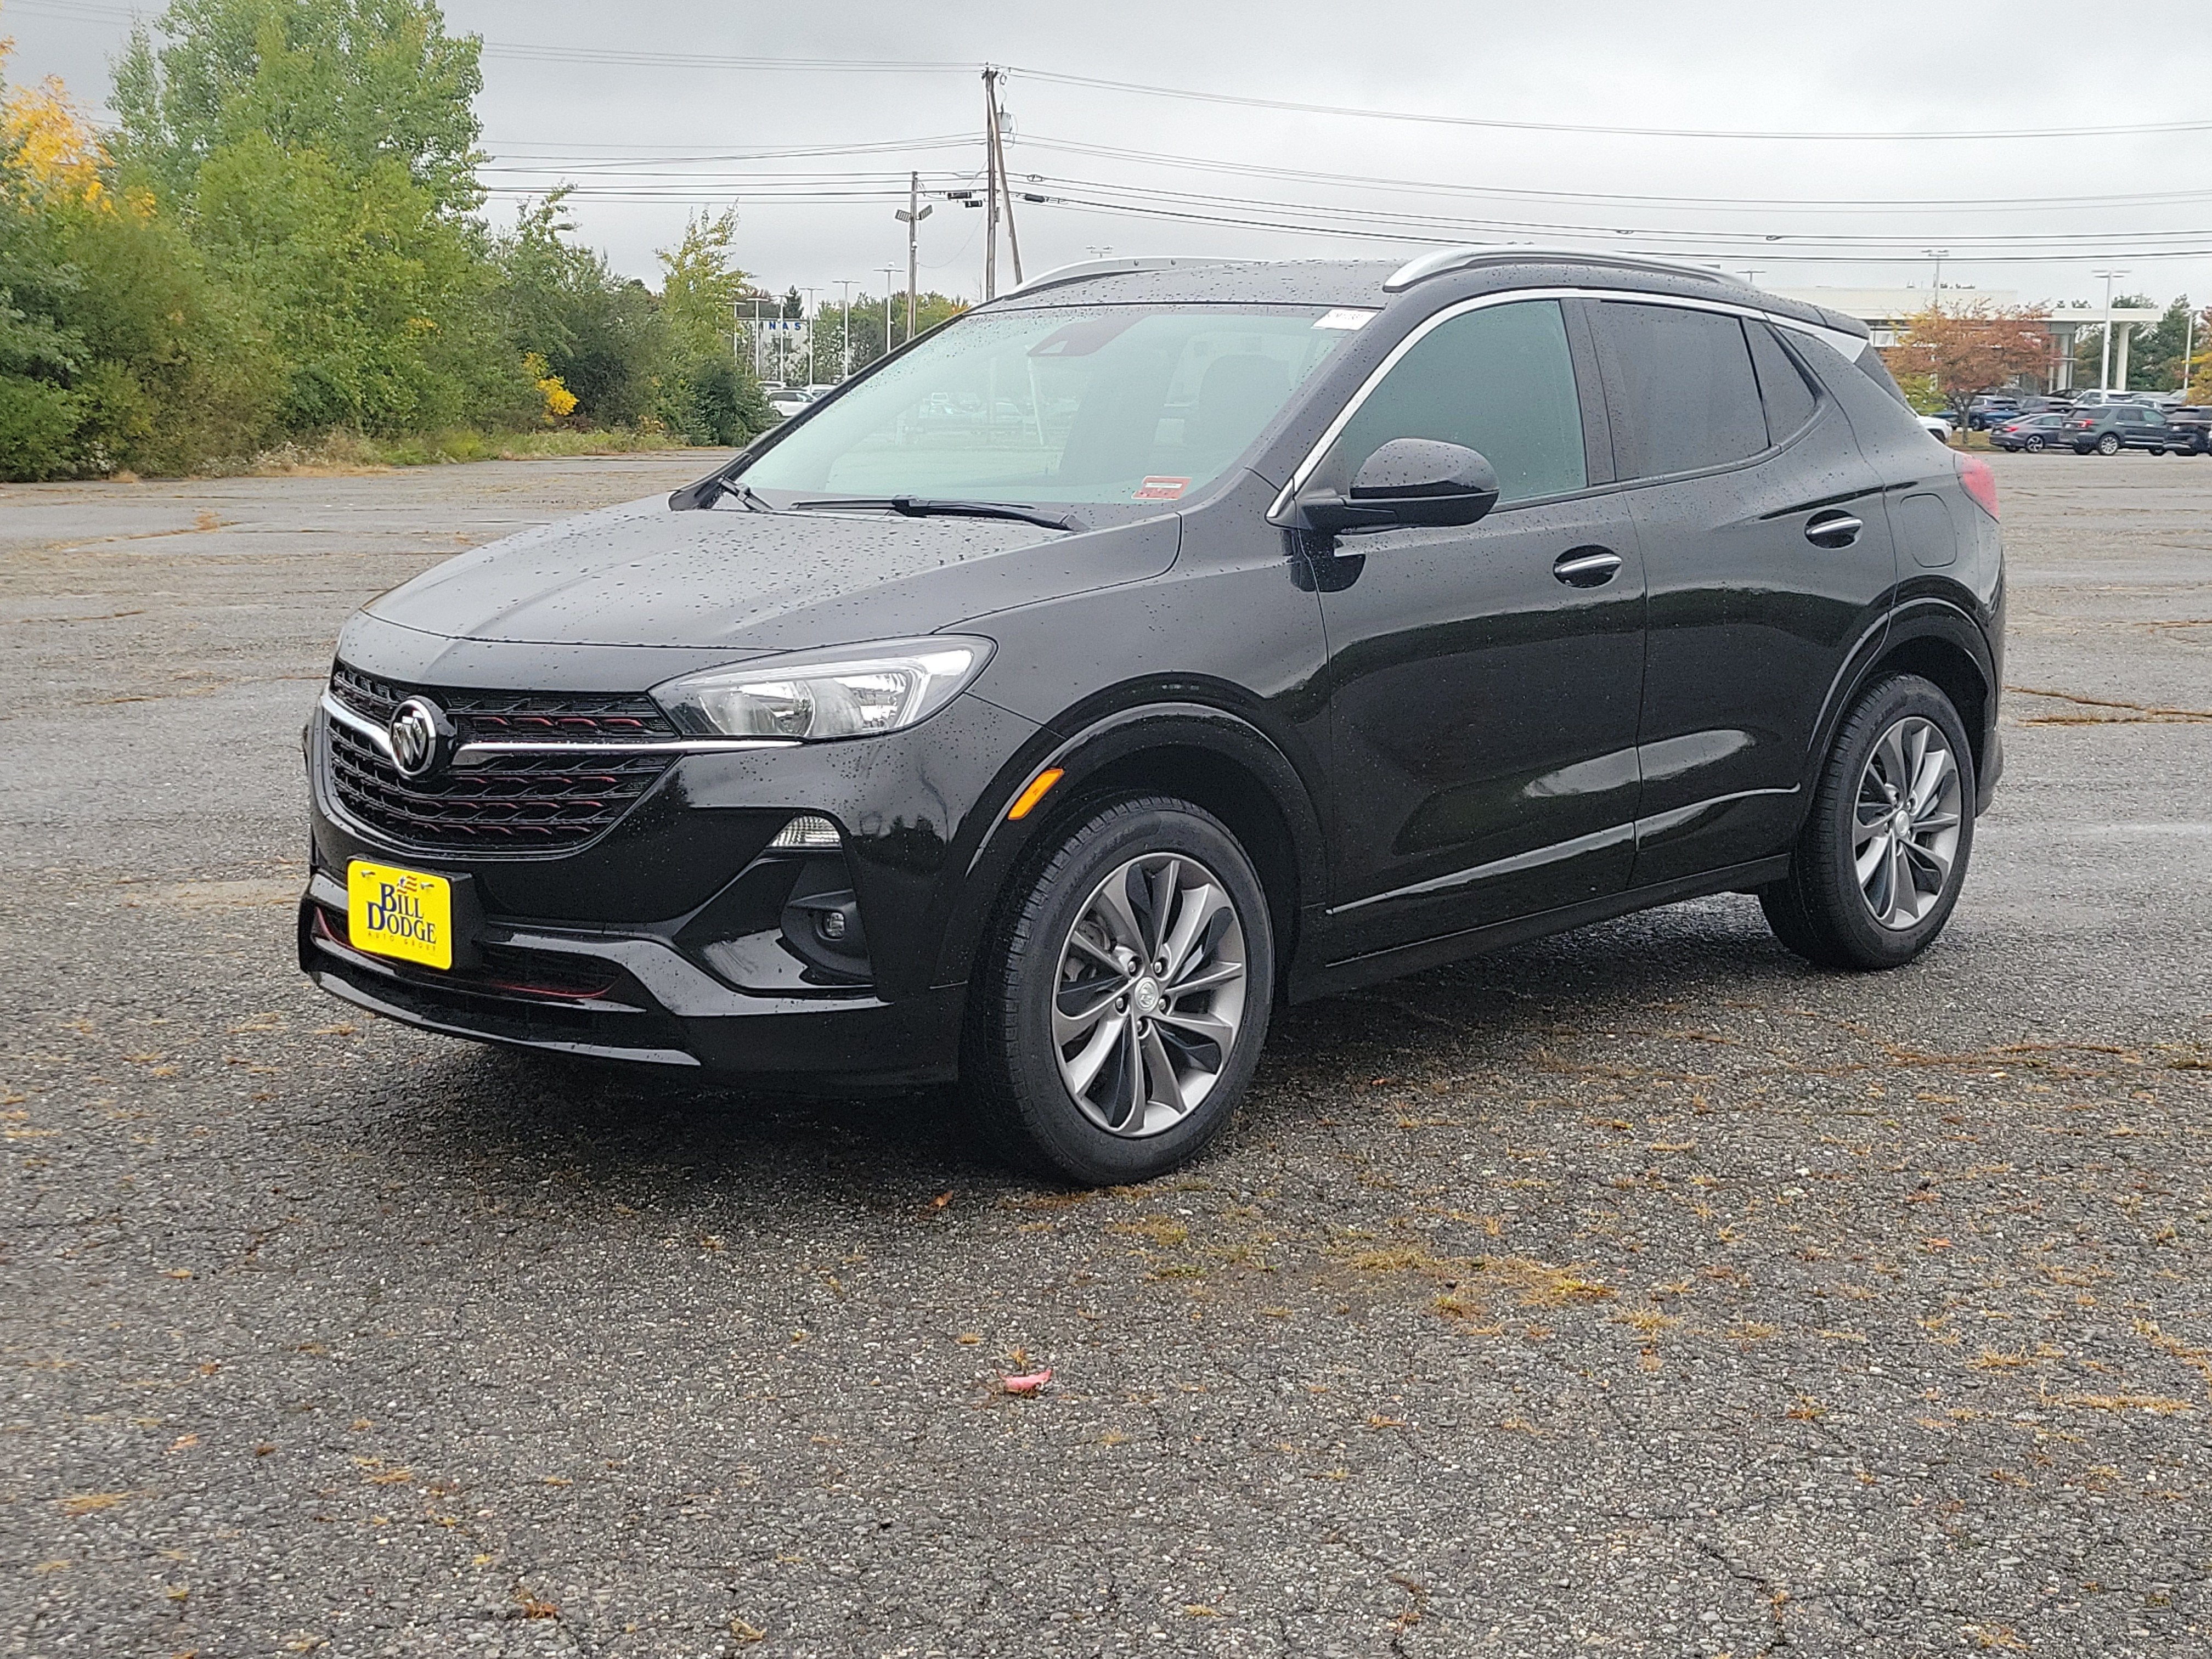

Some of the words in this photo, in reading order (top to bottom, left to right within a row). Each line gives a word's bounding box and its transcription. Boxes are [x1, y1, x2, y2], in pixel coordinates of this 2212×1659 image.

[380, 882, 425, 919] BILL
[366, 901, 437, 944] DODGE
[368, 931, 394, 942] AUTO
